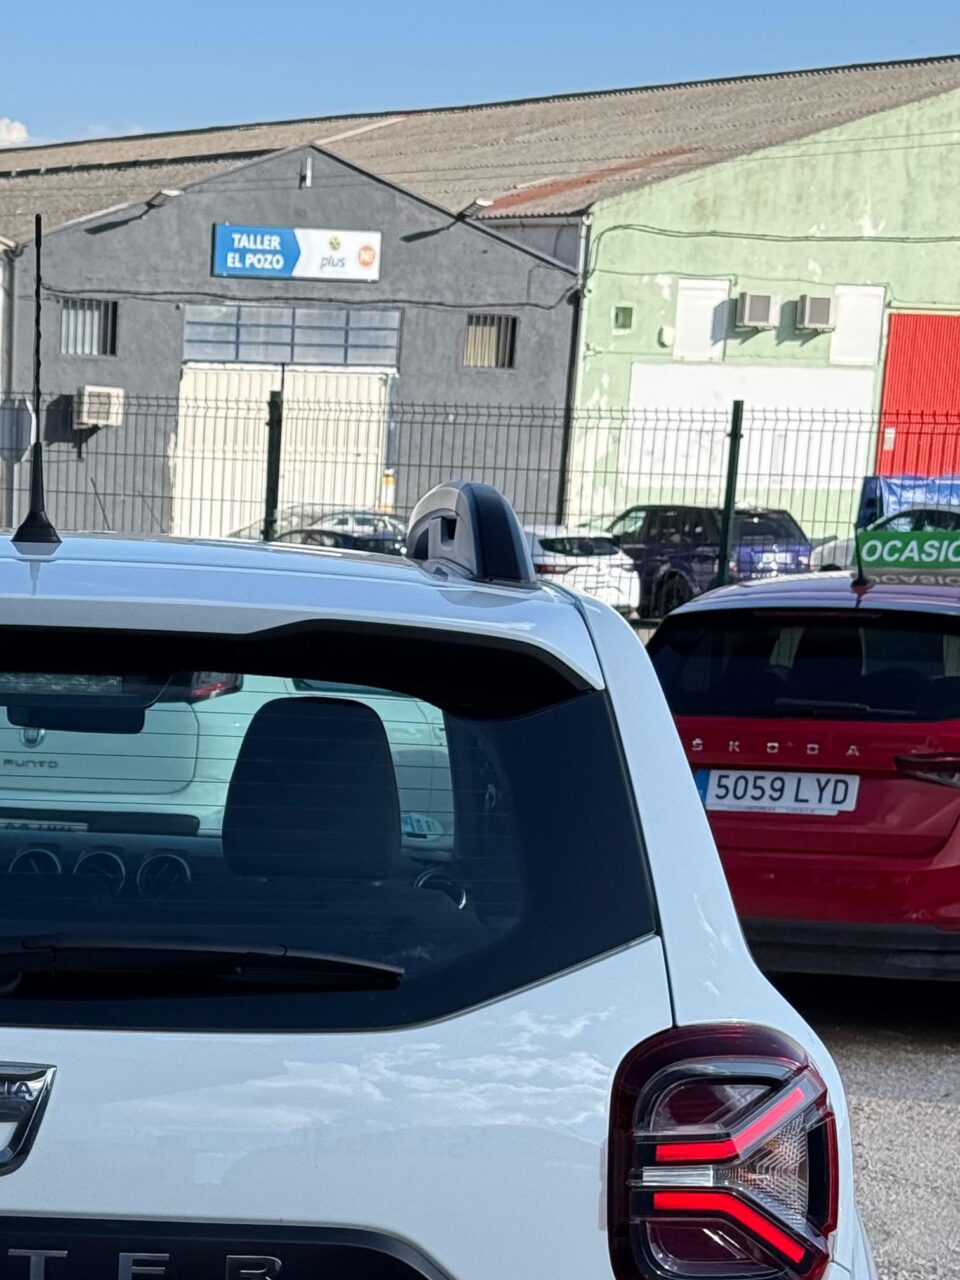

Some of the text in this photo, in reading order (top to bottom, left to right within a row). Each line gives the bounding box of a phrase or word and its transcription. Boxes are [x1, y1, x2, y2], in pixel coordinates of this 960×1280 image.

[232, 233, 281, 250] TALLER
[227, 252, 284, 270] EL POZO
[320, 254, 346, 269] plus
[714, 774, 849, 805] 5059 LYD
